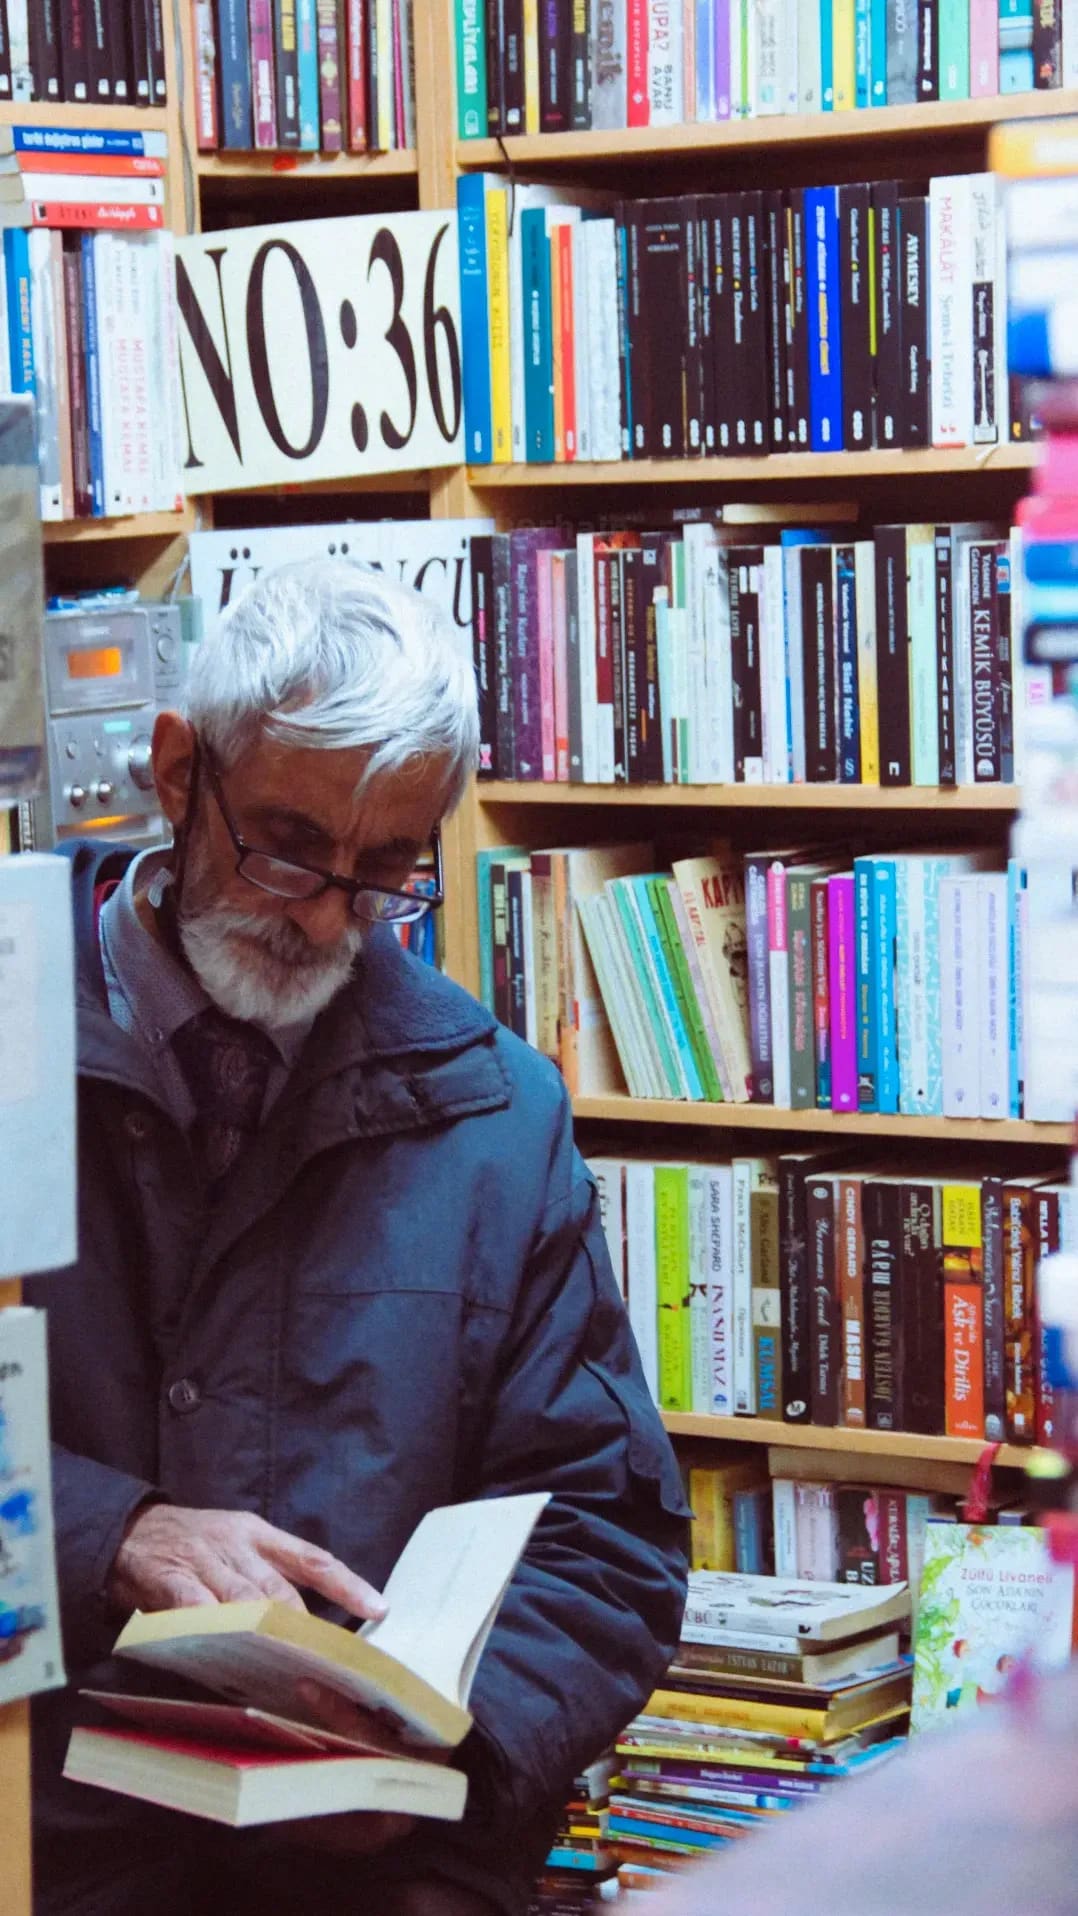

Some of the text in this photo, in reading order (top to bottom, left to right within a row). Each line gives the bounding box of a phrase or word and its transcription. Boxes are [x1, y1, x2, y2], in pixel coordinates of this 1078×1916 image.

[652, 0, 670, 51] UPA?
[973, 609, 995, 756] KEMİK BÜYÜSÜ
[709, 1180, 722, 1272] SARA SHEPARD
[846, 1187, 857, 1277] CINDY GERARD
[919, 1203, 930, 1217] O
[758, 1336, 776, 1410] KUMSAL
[846, 1320, 861, 1381] MASUM
[873, 1290, 891, 1402] JOSTEIN GAARDER
